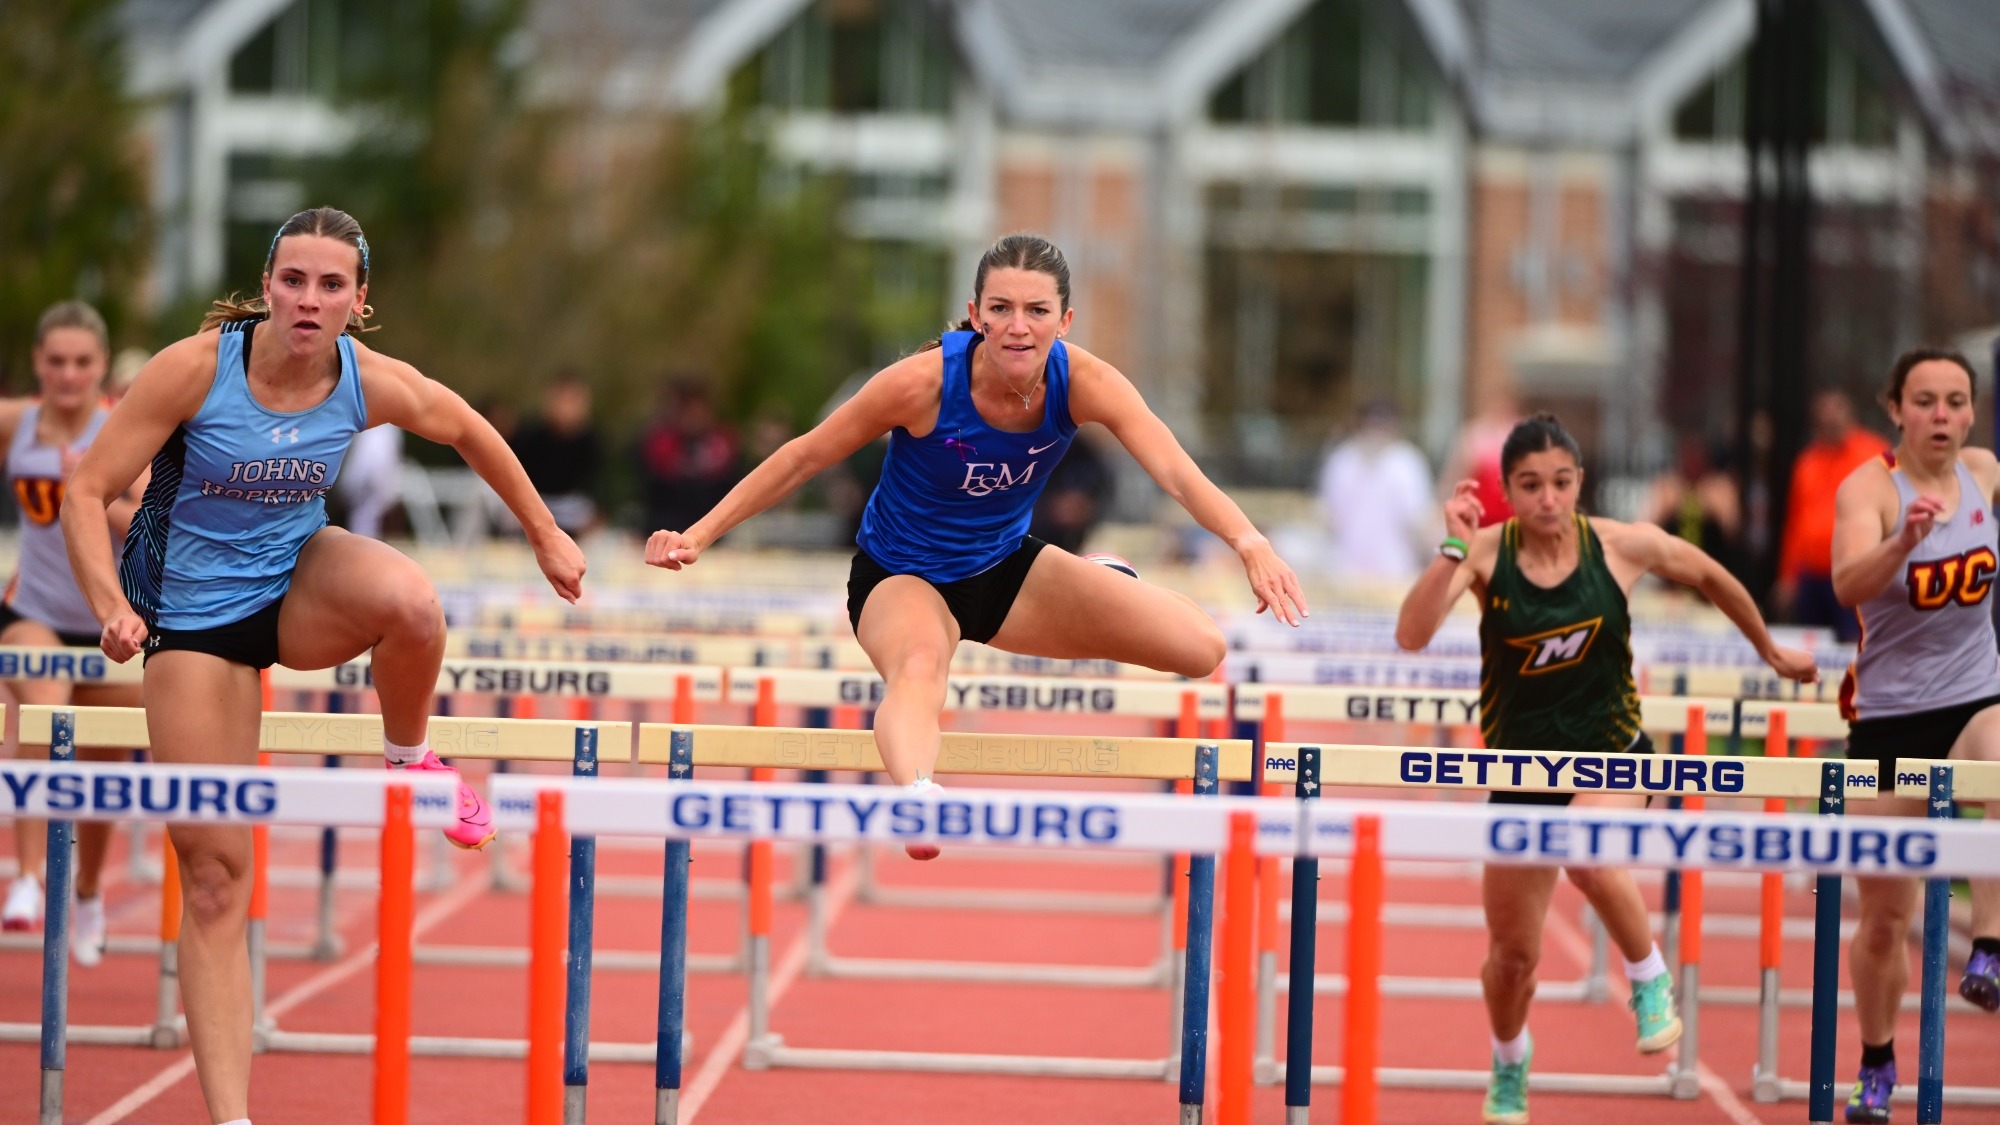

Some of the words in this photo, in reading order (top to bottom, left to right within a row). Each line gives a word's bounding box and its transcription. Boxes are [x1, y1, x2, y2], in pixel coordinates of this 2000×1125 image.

[228, 458, 327, 484] JOHNS
[1908, 546, 1996, 611] UC
[1534, 629, 1589, 667] M
[839, 679, 1115, 711] GEYSBURG
[1, 772, 277, 815] YSBURG
[1400, 752, 1745, 793] GETTYSBURG
[671, 793, 1119, 843] GETTYSBURG
[1488, 818, 1940, 868] GETTYSBURG
